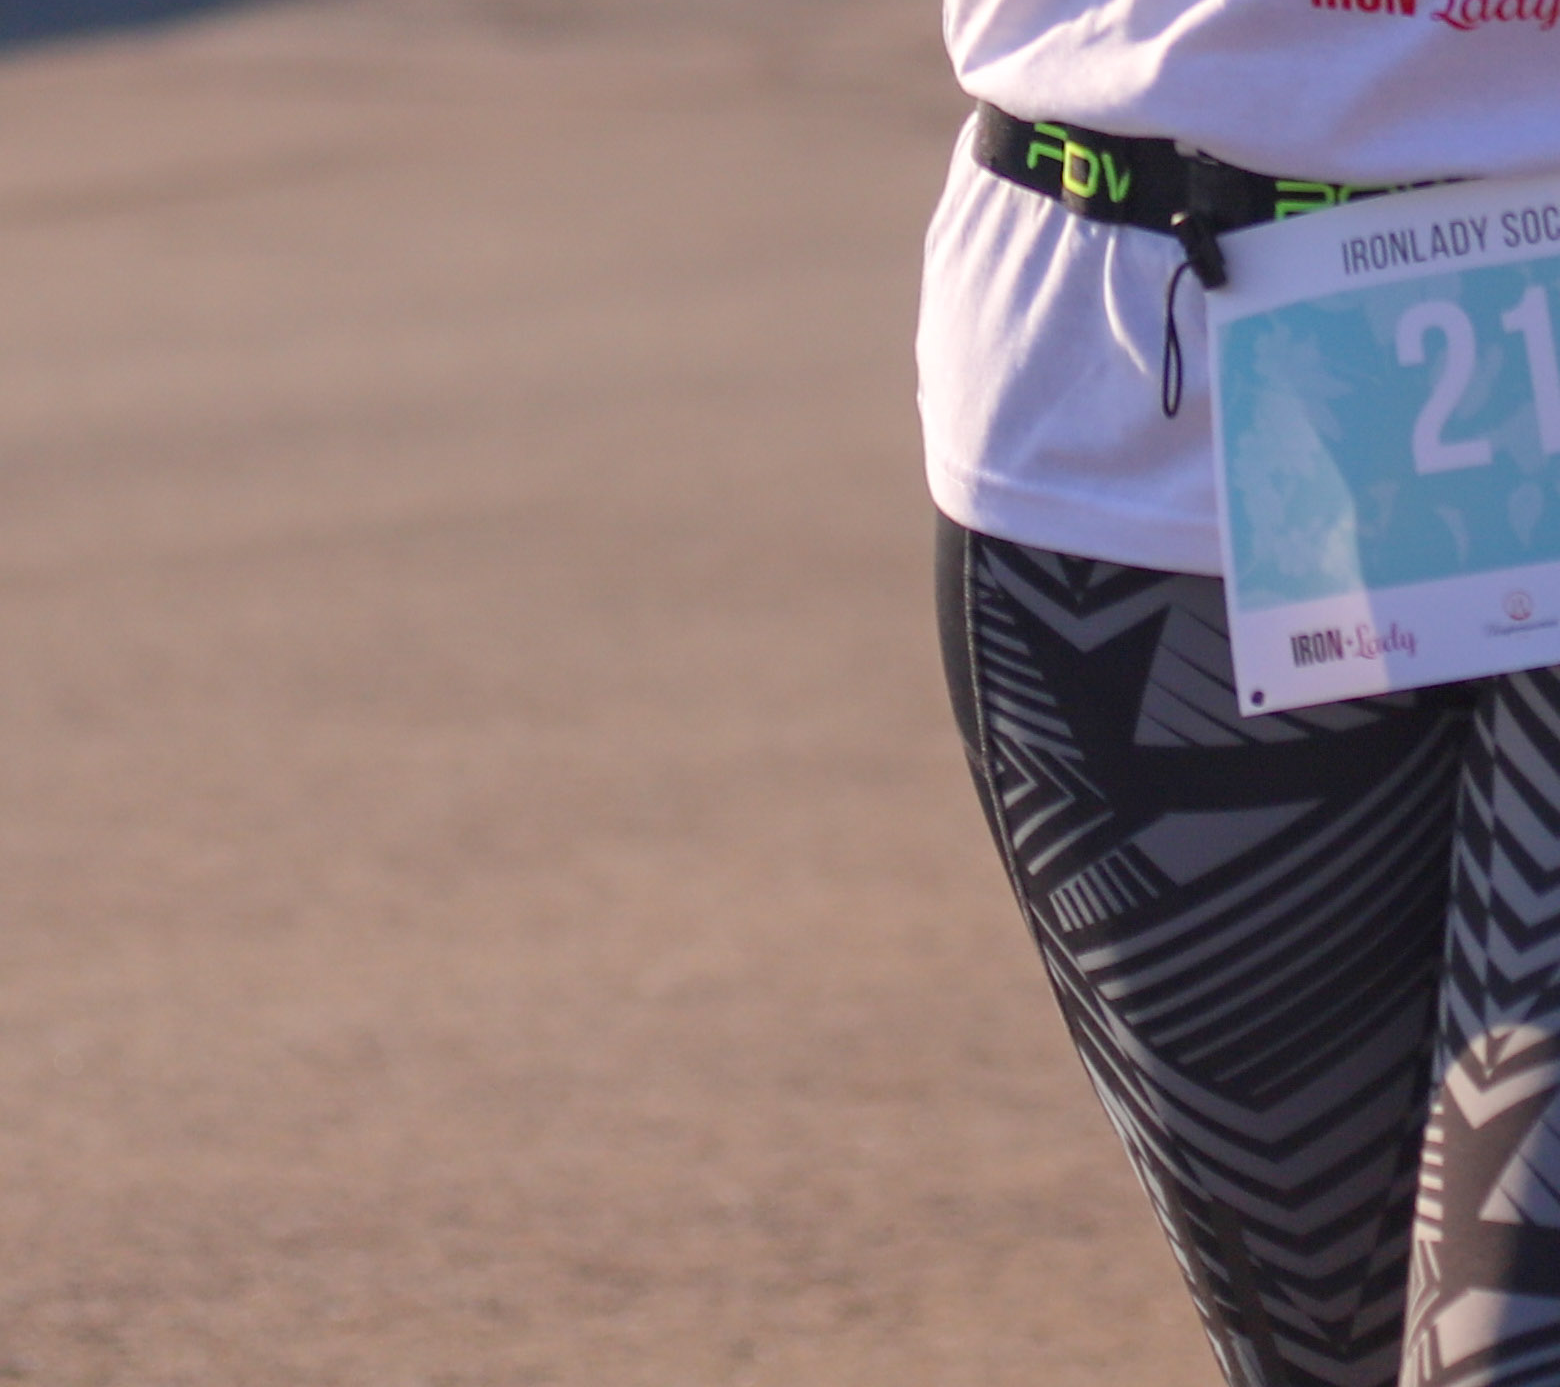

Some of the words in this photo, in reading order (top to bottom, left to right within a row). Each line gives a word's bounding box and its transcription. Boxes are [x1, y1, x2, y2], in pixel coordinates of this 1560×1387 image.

[1340, 213, 1490, 277] IRONLADY
[1290, 627, 1345, 668] IRON
[1353, 621, 1418, 660] Lady
